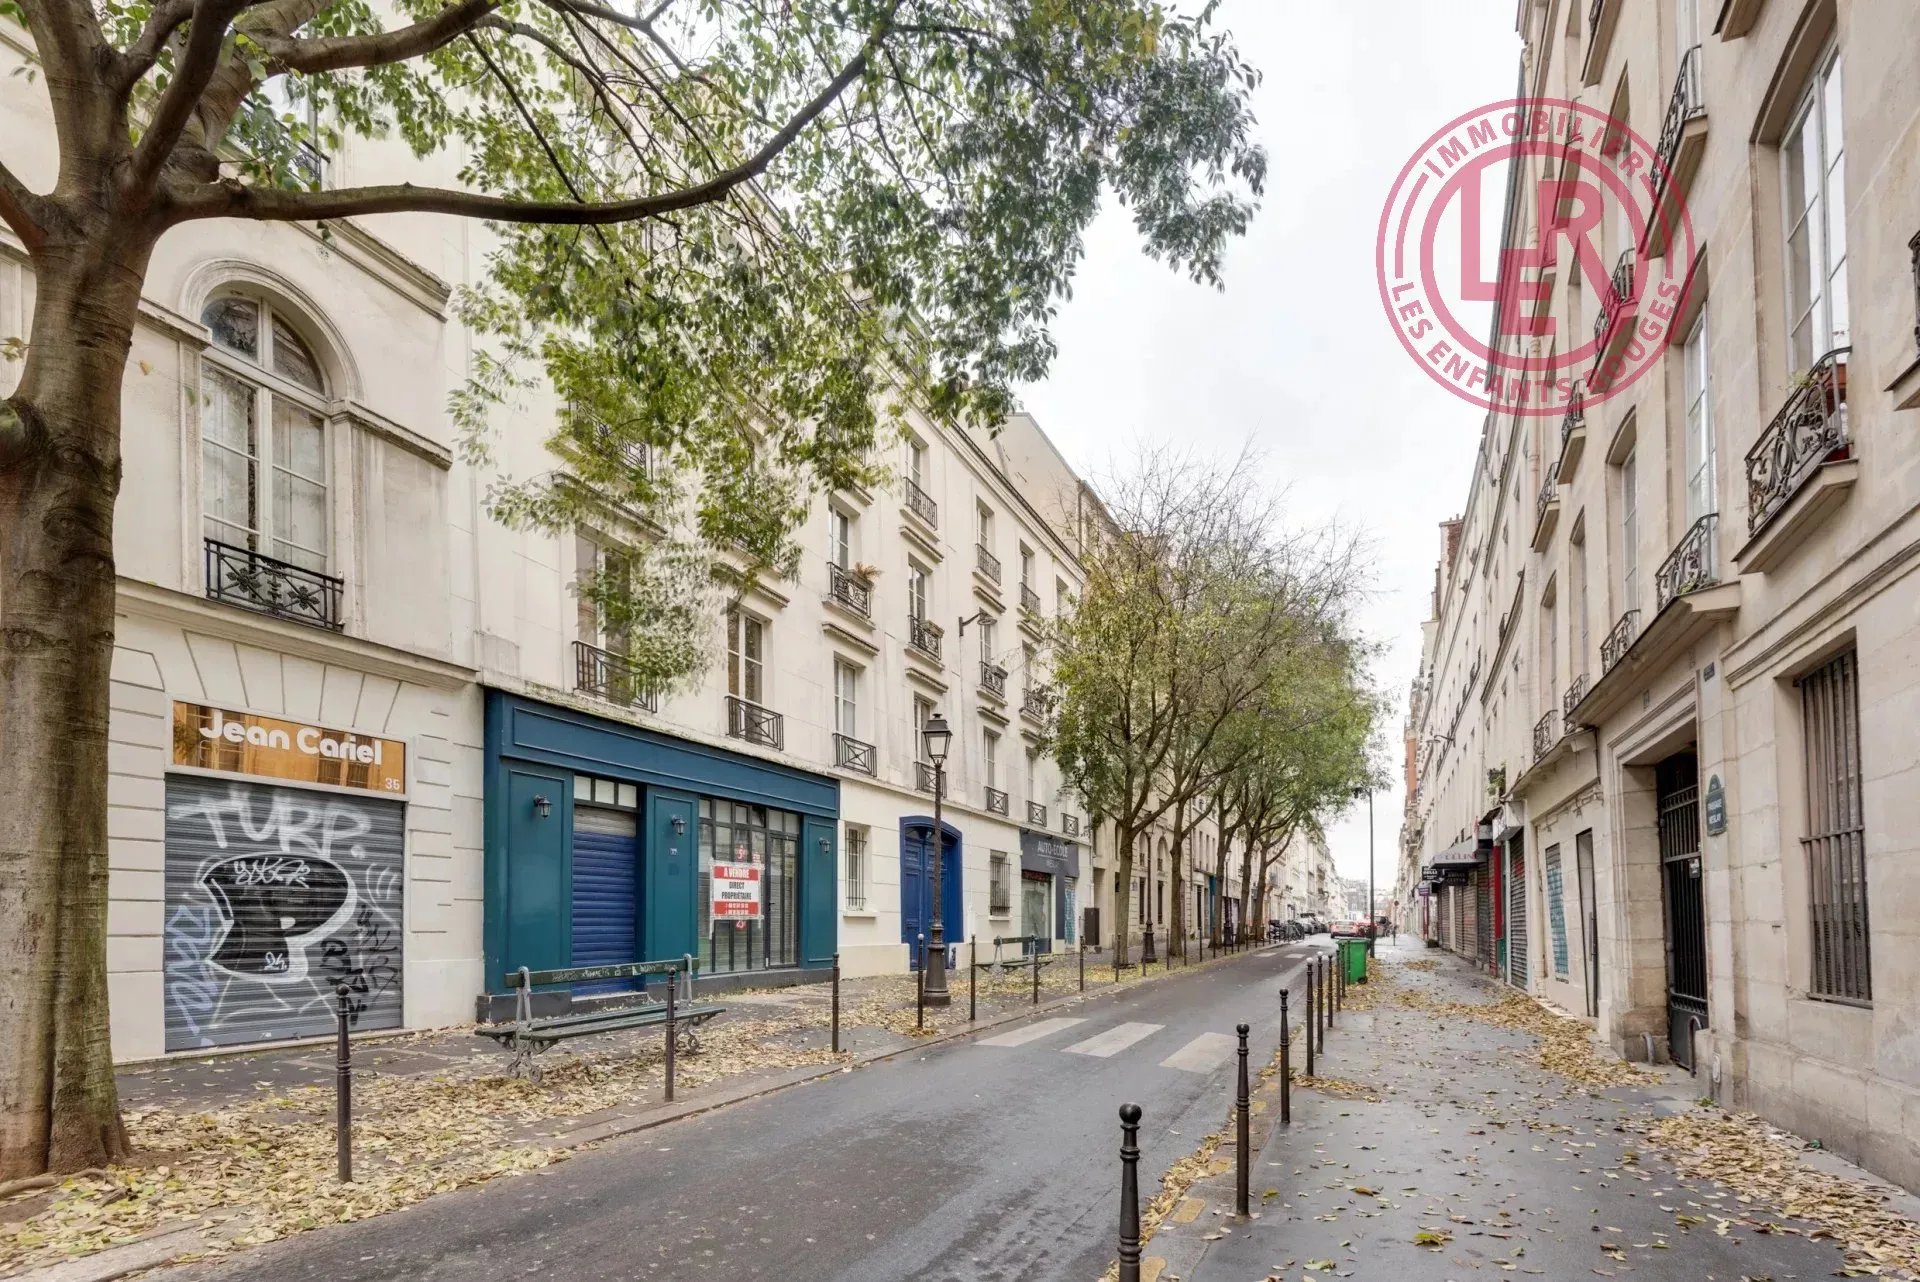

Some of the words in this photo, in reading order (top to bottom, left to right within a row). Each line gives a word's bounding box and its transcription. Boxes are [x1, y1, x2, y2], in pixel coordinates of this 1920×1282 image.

[199, 710, 290, 751] Jean
[296, 728, 382, 765] Cariel
[384, 777, 400, 791] 35
[728, 868, 750, 879] VENDRE
[729, 881, 745, 890] DIRECT
